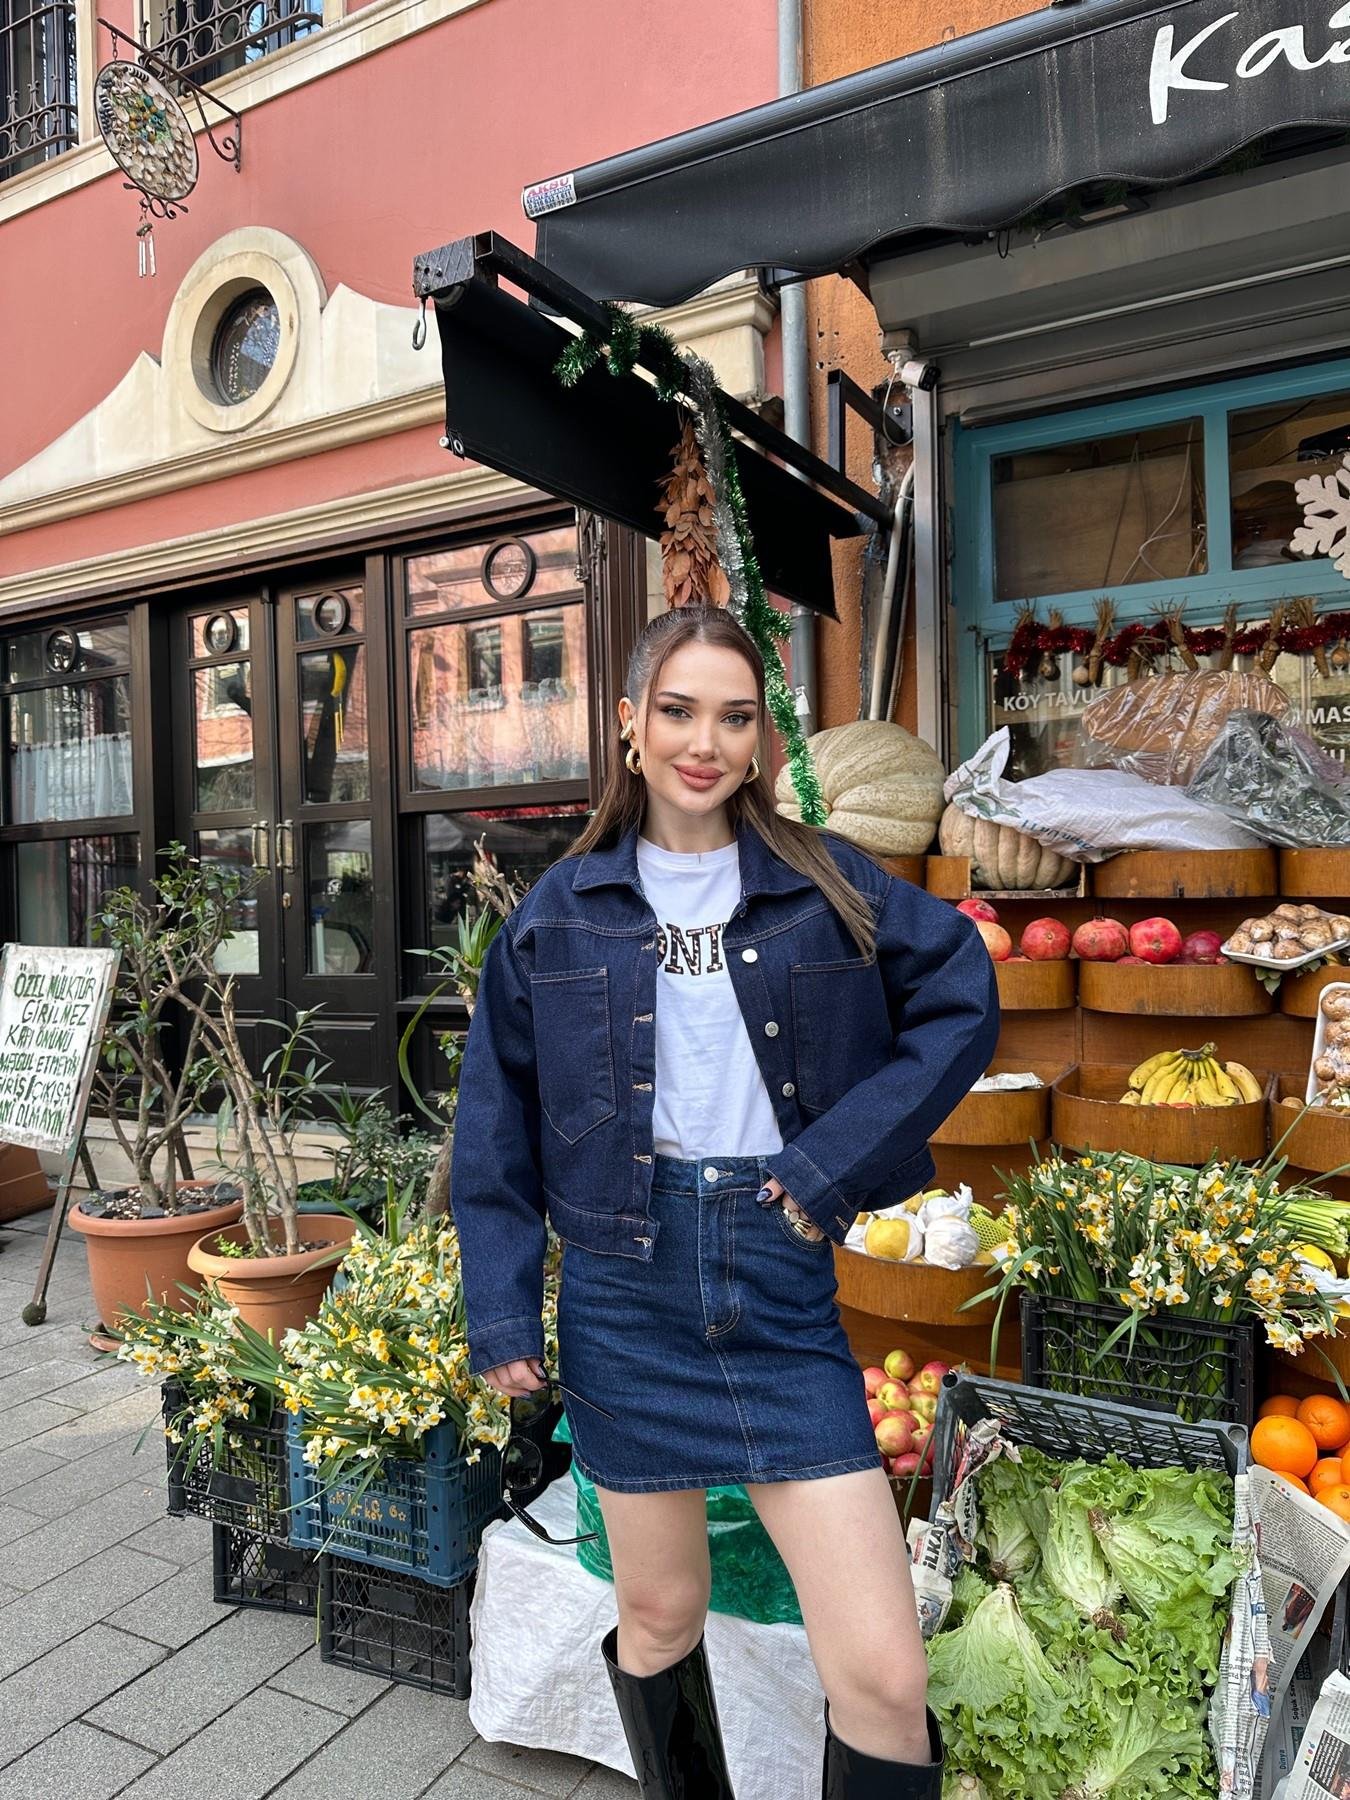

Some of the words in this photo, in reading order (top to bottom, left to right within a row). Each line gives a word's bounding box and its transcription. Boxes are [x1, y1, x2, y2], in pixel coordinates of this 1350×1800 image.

[1149, 11, 1350, 125] Ka
[528, 177, 569, 197] AKSU
[1003, 692, 1041, 712] KÖY
[1044, 689, 1095, 708] TAVU
[1305, 705, 1350, 725] MAS
[14, 962, 46, 998] ÖZEL
[47, 965, 97, 1002] MÜLKTÜR
[4, 1024, 35, 1049] KAPI
